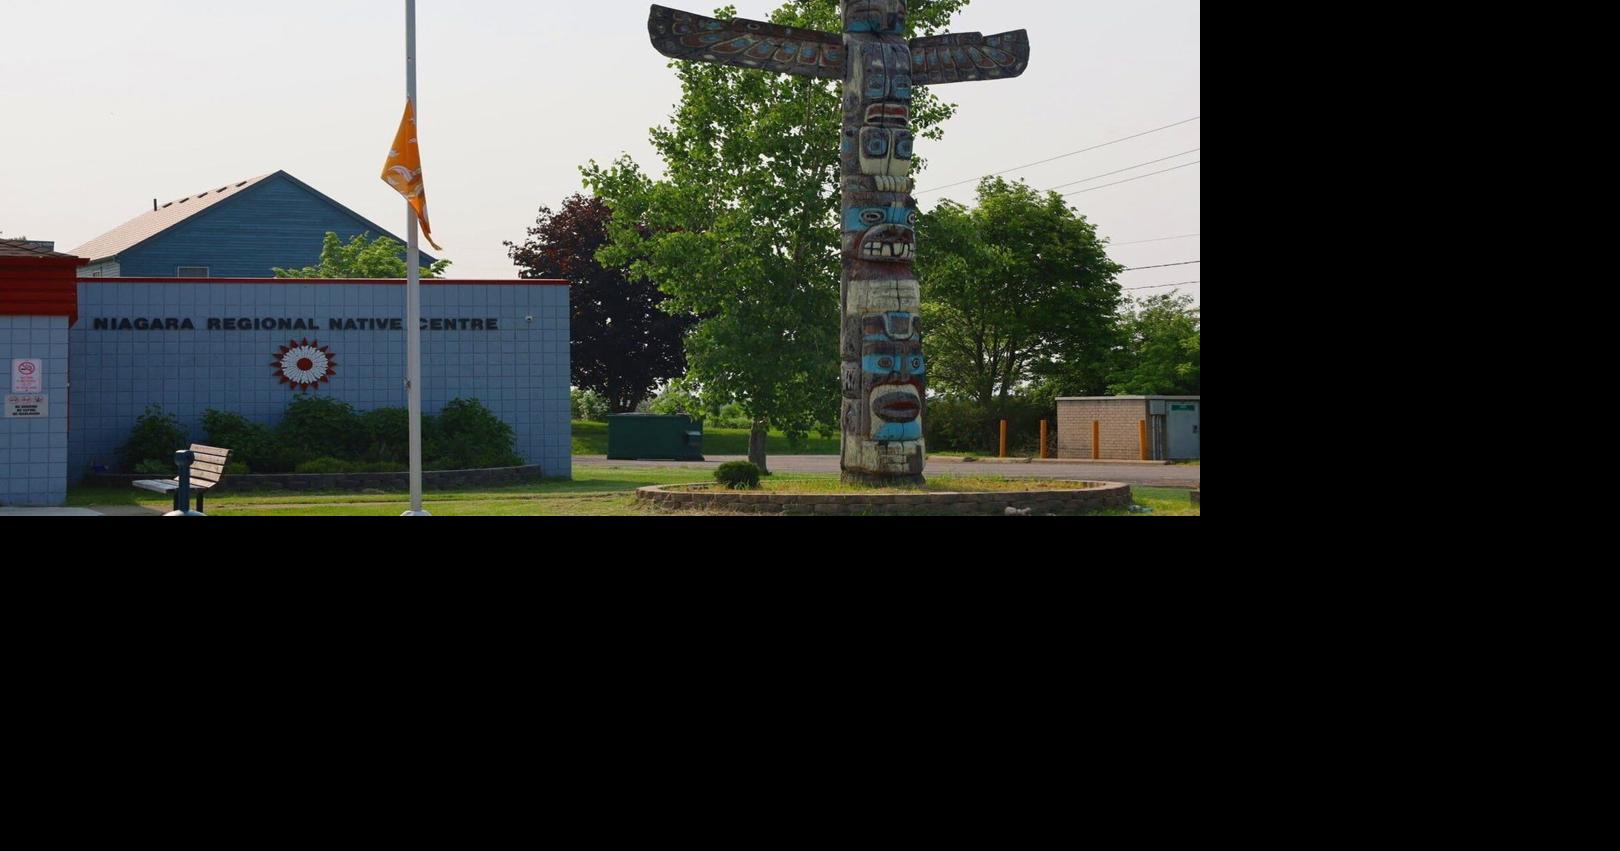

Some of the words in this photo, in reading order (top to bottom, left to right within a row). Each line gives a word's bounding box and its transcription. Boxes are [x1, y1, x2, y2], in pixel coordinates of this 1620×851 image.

[94, 317, 194, 330] NIAGARA
[207, 317, 319, 330] REGIONAL
[329, 317, 403, 331] NATIVE
[418, 317, 499, 331] CENTRE
